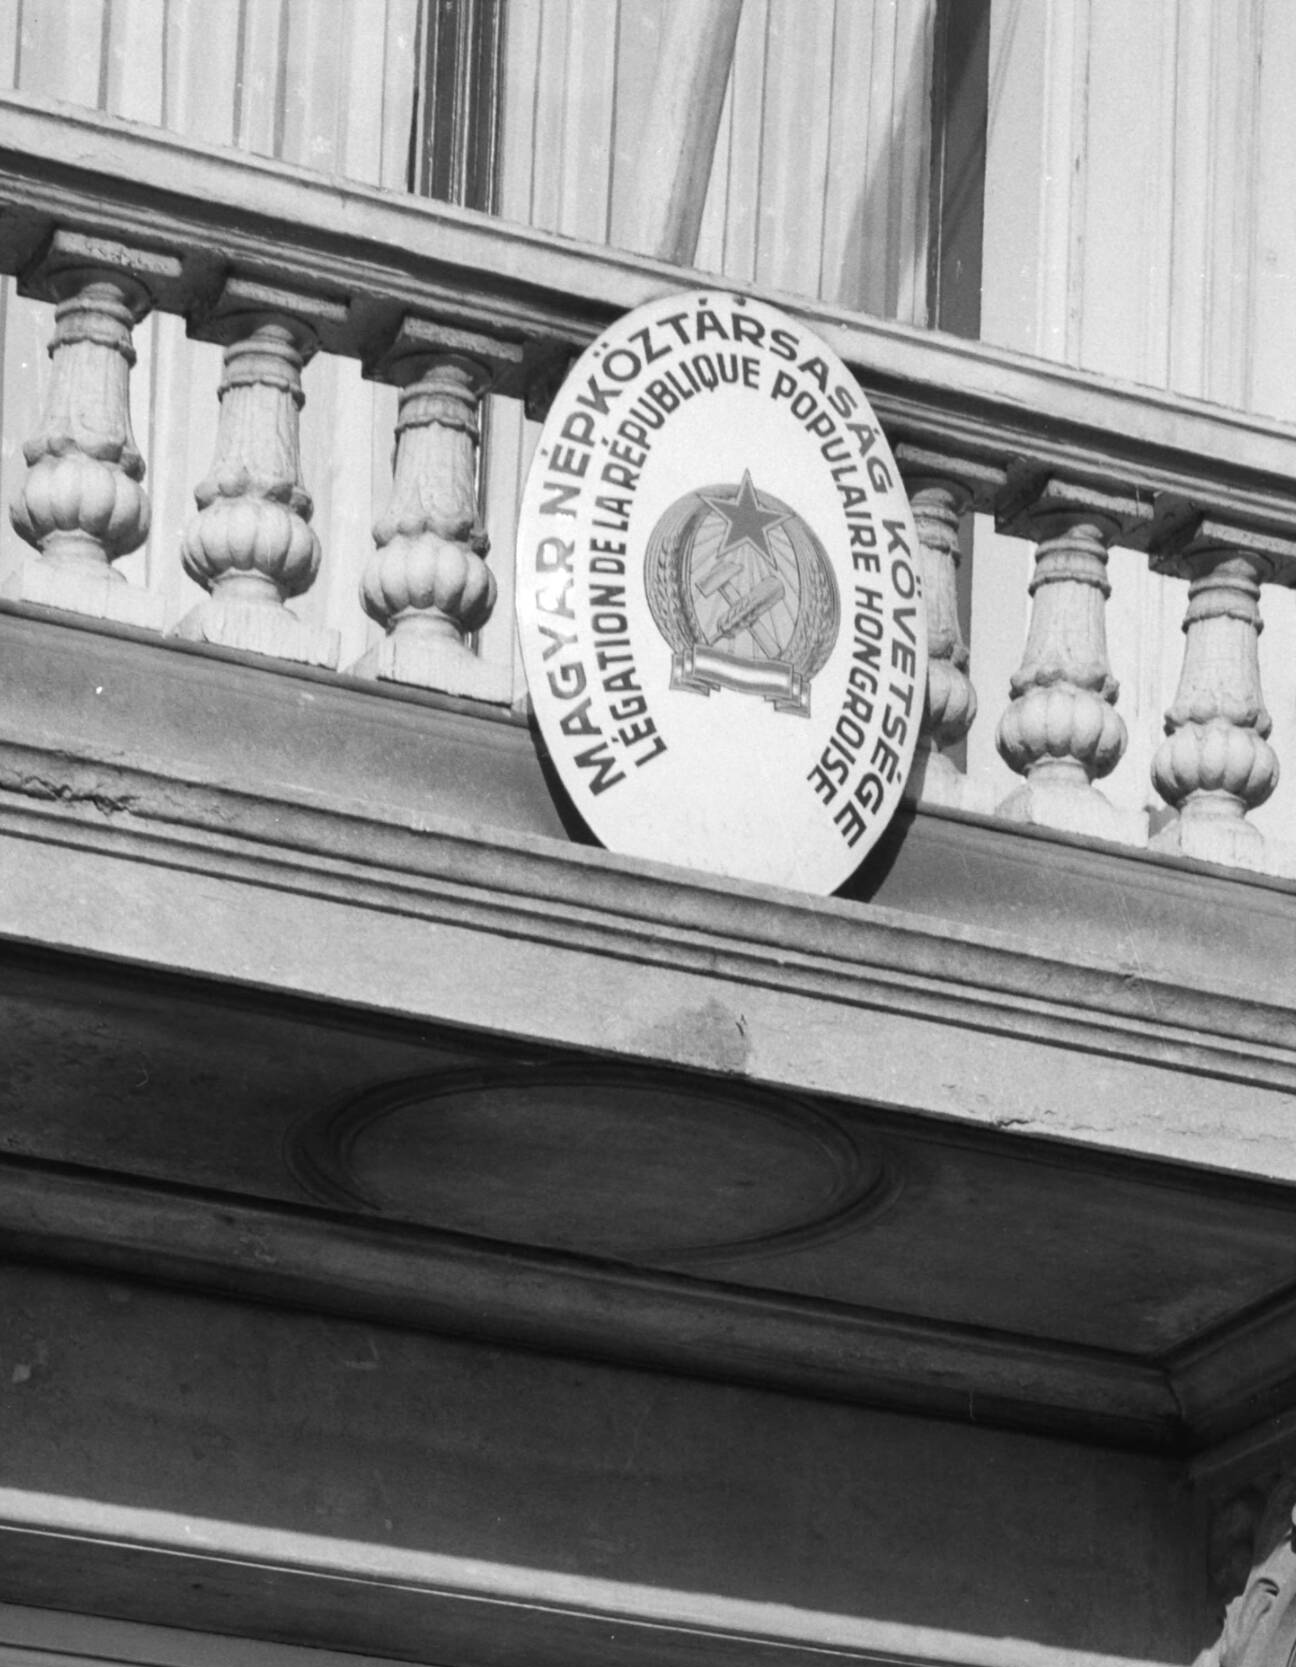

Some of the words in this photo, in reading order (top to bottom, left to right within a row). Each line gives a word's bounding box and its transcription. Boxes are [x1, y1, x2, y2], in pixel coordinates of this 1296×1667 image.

[538, 297, 894, 519] NÉPKÖZTÁRSASÁG
[600, 352, 761, 490] RÉPUBLIQUE
[770, 369, 881, 574] POPULAIRE
[588, 538, 627, 575] DE
[592, 495, 633, 532] LA
[536, 537, 627, 797] MAGYAR
[588, 583, 668, 767] LÉGATION
[806, 585, 884, 806] HONGROISE
[833, 518, 922, 848] KÖVETSÉGE
